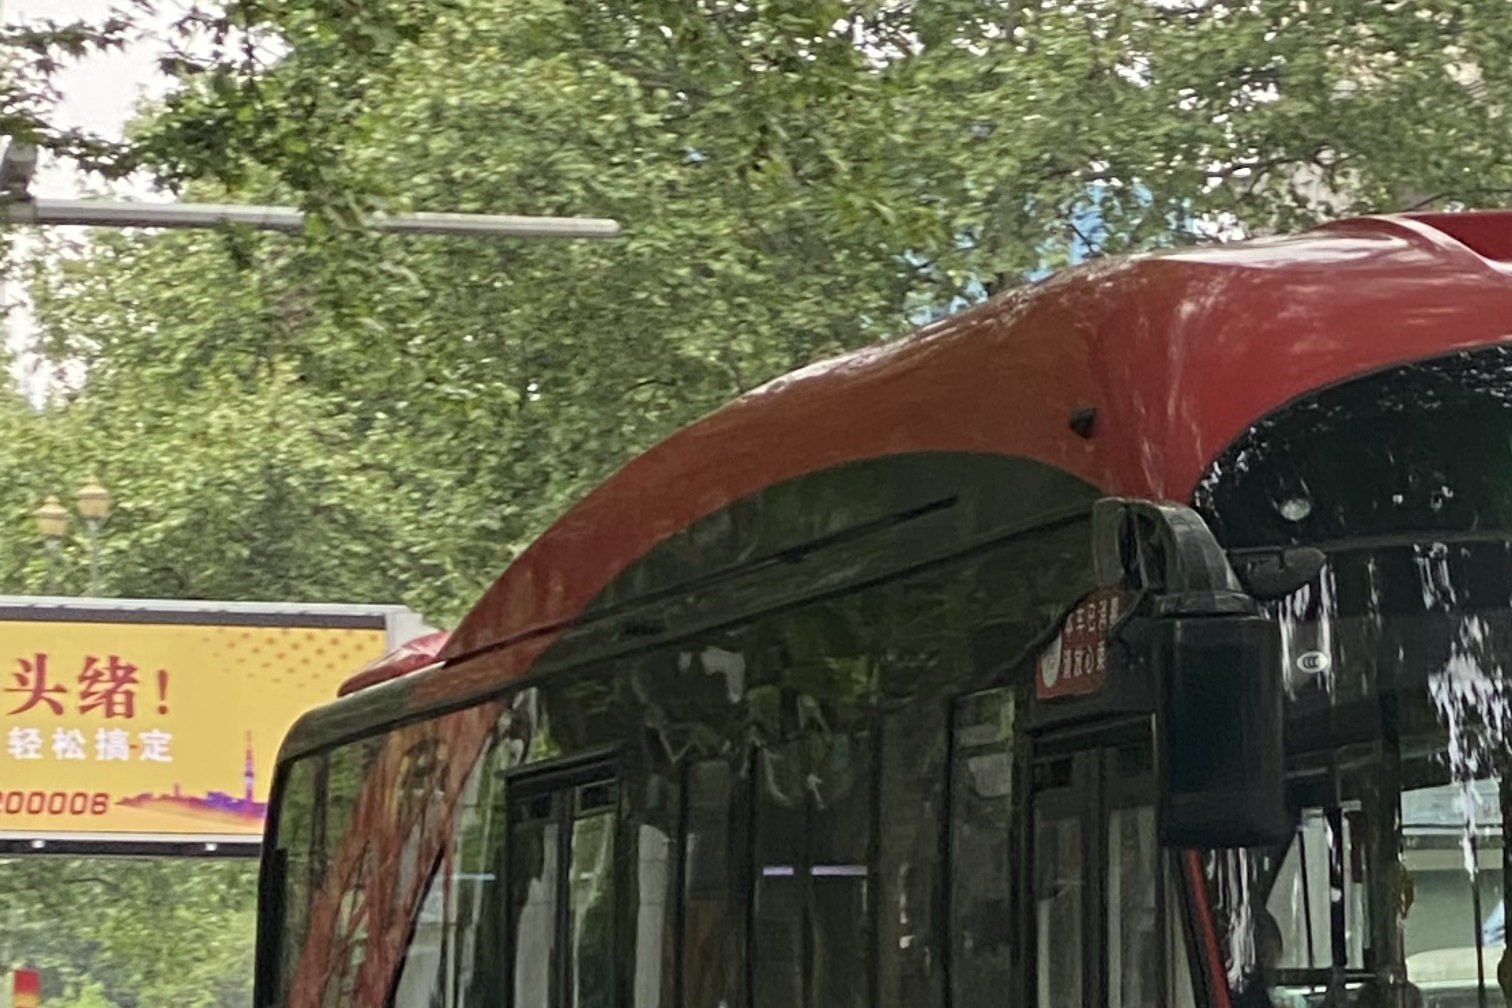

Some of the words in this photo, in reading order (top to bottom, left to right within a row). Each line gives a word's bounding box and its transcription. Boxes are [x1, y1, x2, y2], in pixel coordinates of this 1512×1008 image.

[7, 726, 174, 763] 轻松搞定
[0, 790, 110, 816] 00006
